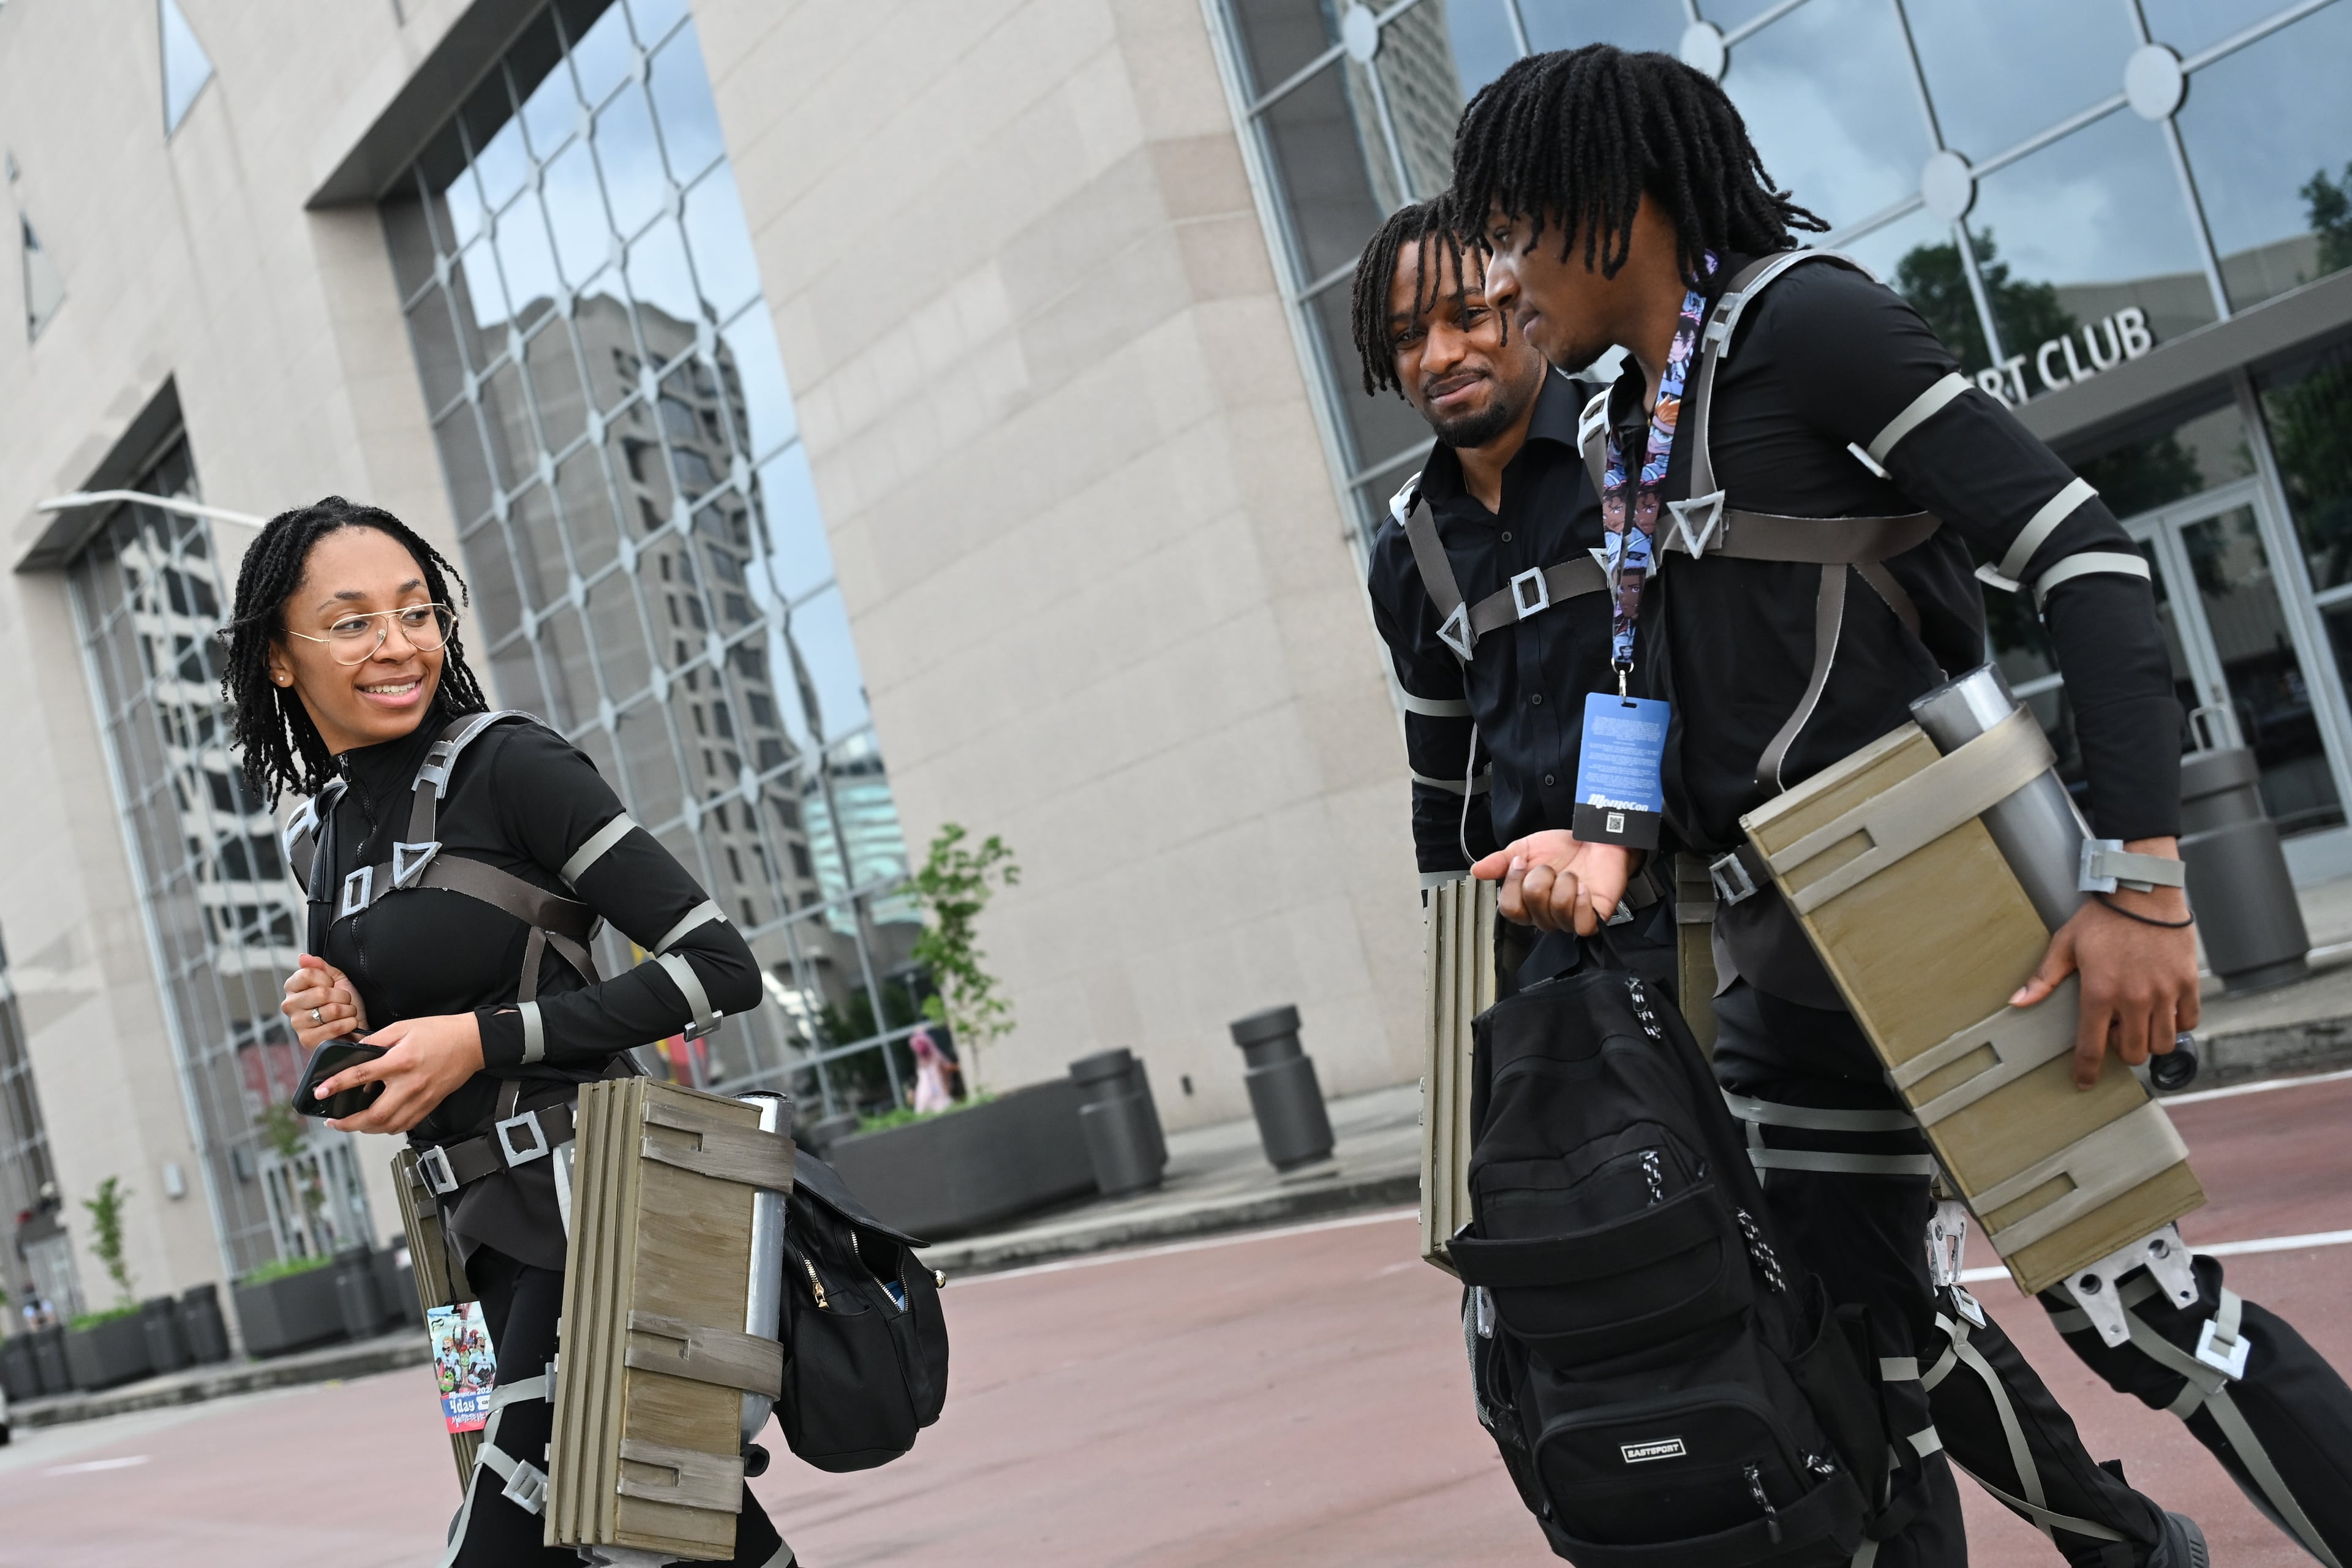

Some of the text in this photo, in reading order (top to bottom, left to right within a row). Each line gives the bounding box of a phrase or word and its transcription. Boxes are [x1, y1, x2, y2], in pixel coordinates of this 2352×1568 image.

[1965, 306, 2152, 412] RT CLUB
[1587, 793, 1649, 812] MomoCon
[450, 1398, 475, 1414] 4day
[1627, 1444, 1679, 1458] EASTSPORT
